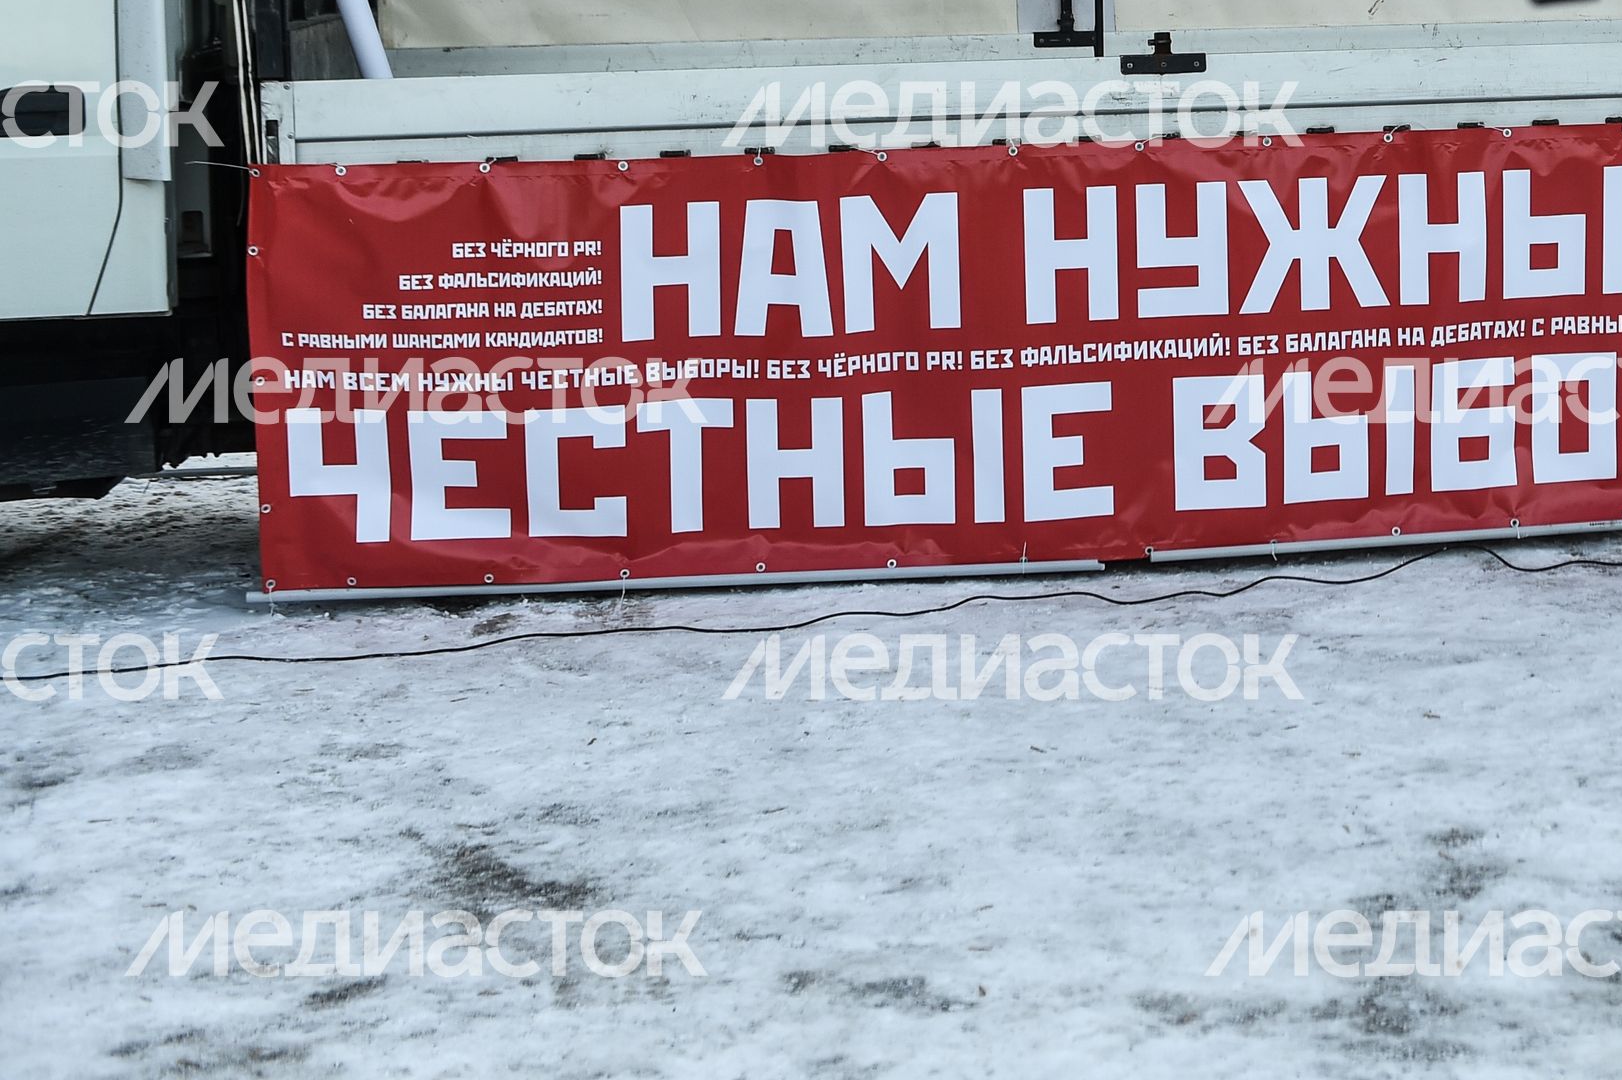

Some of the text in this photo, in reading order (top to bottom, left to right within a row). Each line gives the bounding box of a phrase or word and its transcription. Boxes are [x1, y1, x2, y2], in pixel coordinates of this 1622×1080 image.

[452, 239, 602, 259] БЕЗ ЧЁРНОГО PR!
[399, 267, 602, 291] БЕЗ ФАЛЬСИФИКАЦИЙ!
[618, 191, 962, 343] НАМ
[362, 299, 603, 320] БЕЗ БАЛАГАНА НА ДЕБАТАХ!
[281, 328, 603, 349] С РАВНЫМИ ШАНСАМИ КАНДИДАТОВ!
[284, 369, 335, 390] НАМ
[342, 371, 410, 392] ВСЕМ
[417, 370, 513, 392] НУЖНЫ
[521, 363, 638, 390] ЧЕСТНЫЕ
[645, 358, 760, 383] ВЫБОРЫ!
[766, 359, 811, 380] БЕЗ
[817, 352, 918, 378] ЧЁРНОГО
[926, 350, 963, 371] PR!
[970, 350, 1014, 371] БЕЗ
[1020, 332, 1231, 367] ФАЛЬСИФИКАЦИЙ!
[1238, 335, 1279, 356] БЕЗ
[1286, 327, 1392, 354] БАЛАГАНА
[1397, 326, 1425, 347] НА
[1431, 319, 1525, 348] ДЕБАТАХ!
[1531, 317, 1545, 337] С
[285, 380, 1114, 543] ЧЕСТНЫЕ
